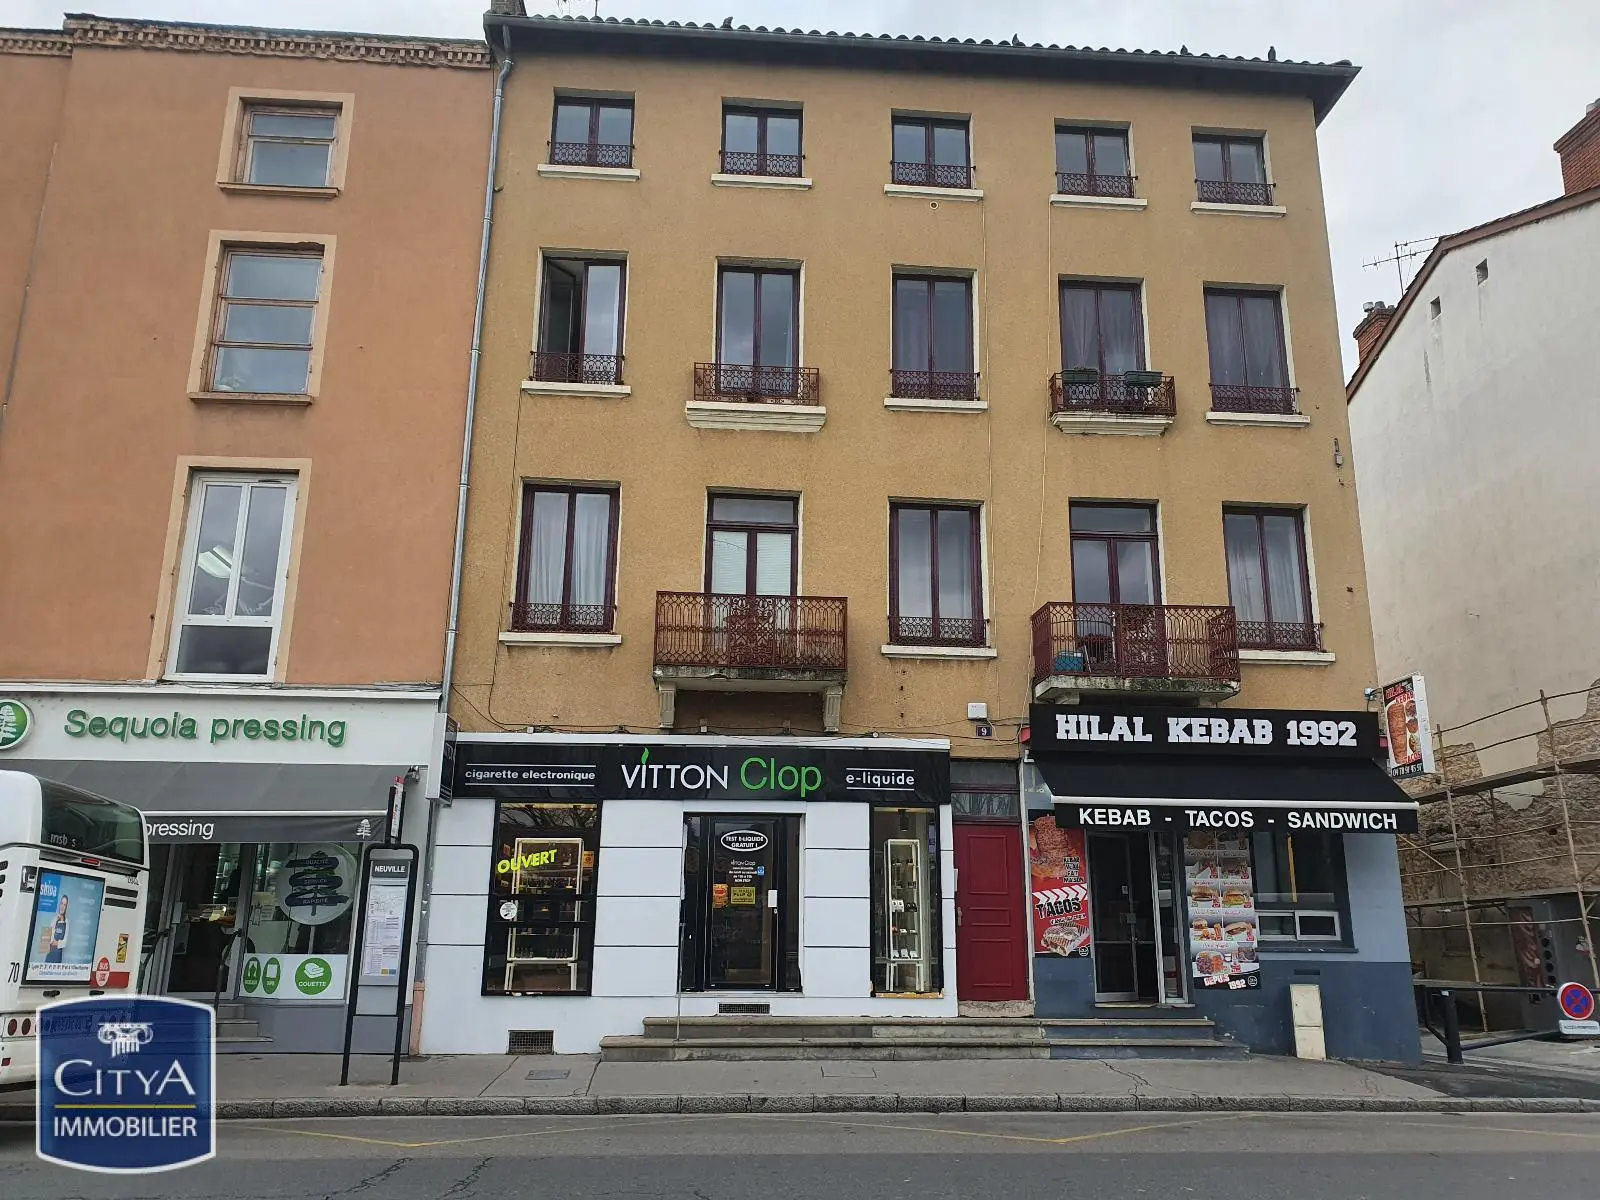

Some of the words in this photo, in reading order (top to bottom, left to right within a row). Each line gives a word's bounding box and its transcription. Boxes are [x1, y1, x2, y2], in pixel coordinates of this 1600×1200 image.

[64, 709, 198, 743] Sequoia
[209, 714, 346, 748] pressing
[981, 728, 987, 736] 9
[1055, 714, 1152, 742] HILAL
[1168, 717, 1272, 745] KEBAB
[1287, 720, 1357, 747] 1992
[465, 769, 519, 780] cigarette
[522, 769, 596, 781] electronique
[621, 756, 729, 790] VITTON
[740, 757, 822, 798] Clop
[846, 772, 915, 787] e-liquide
[1079, 808, 1151, 826] KEBAB
[1185, 810, 1254, 828] TACOS
[1288, 812, 1397, 830] SANDWICH
[374, 865, 406, 873] NEUVILLE
[497, 849, 557, 874] OUVERT
[1036, 897, 1082, 919] TACOS
[8, 962, 20, 984] 70
[1228, 979, 1247, 990] 1992
